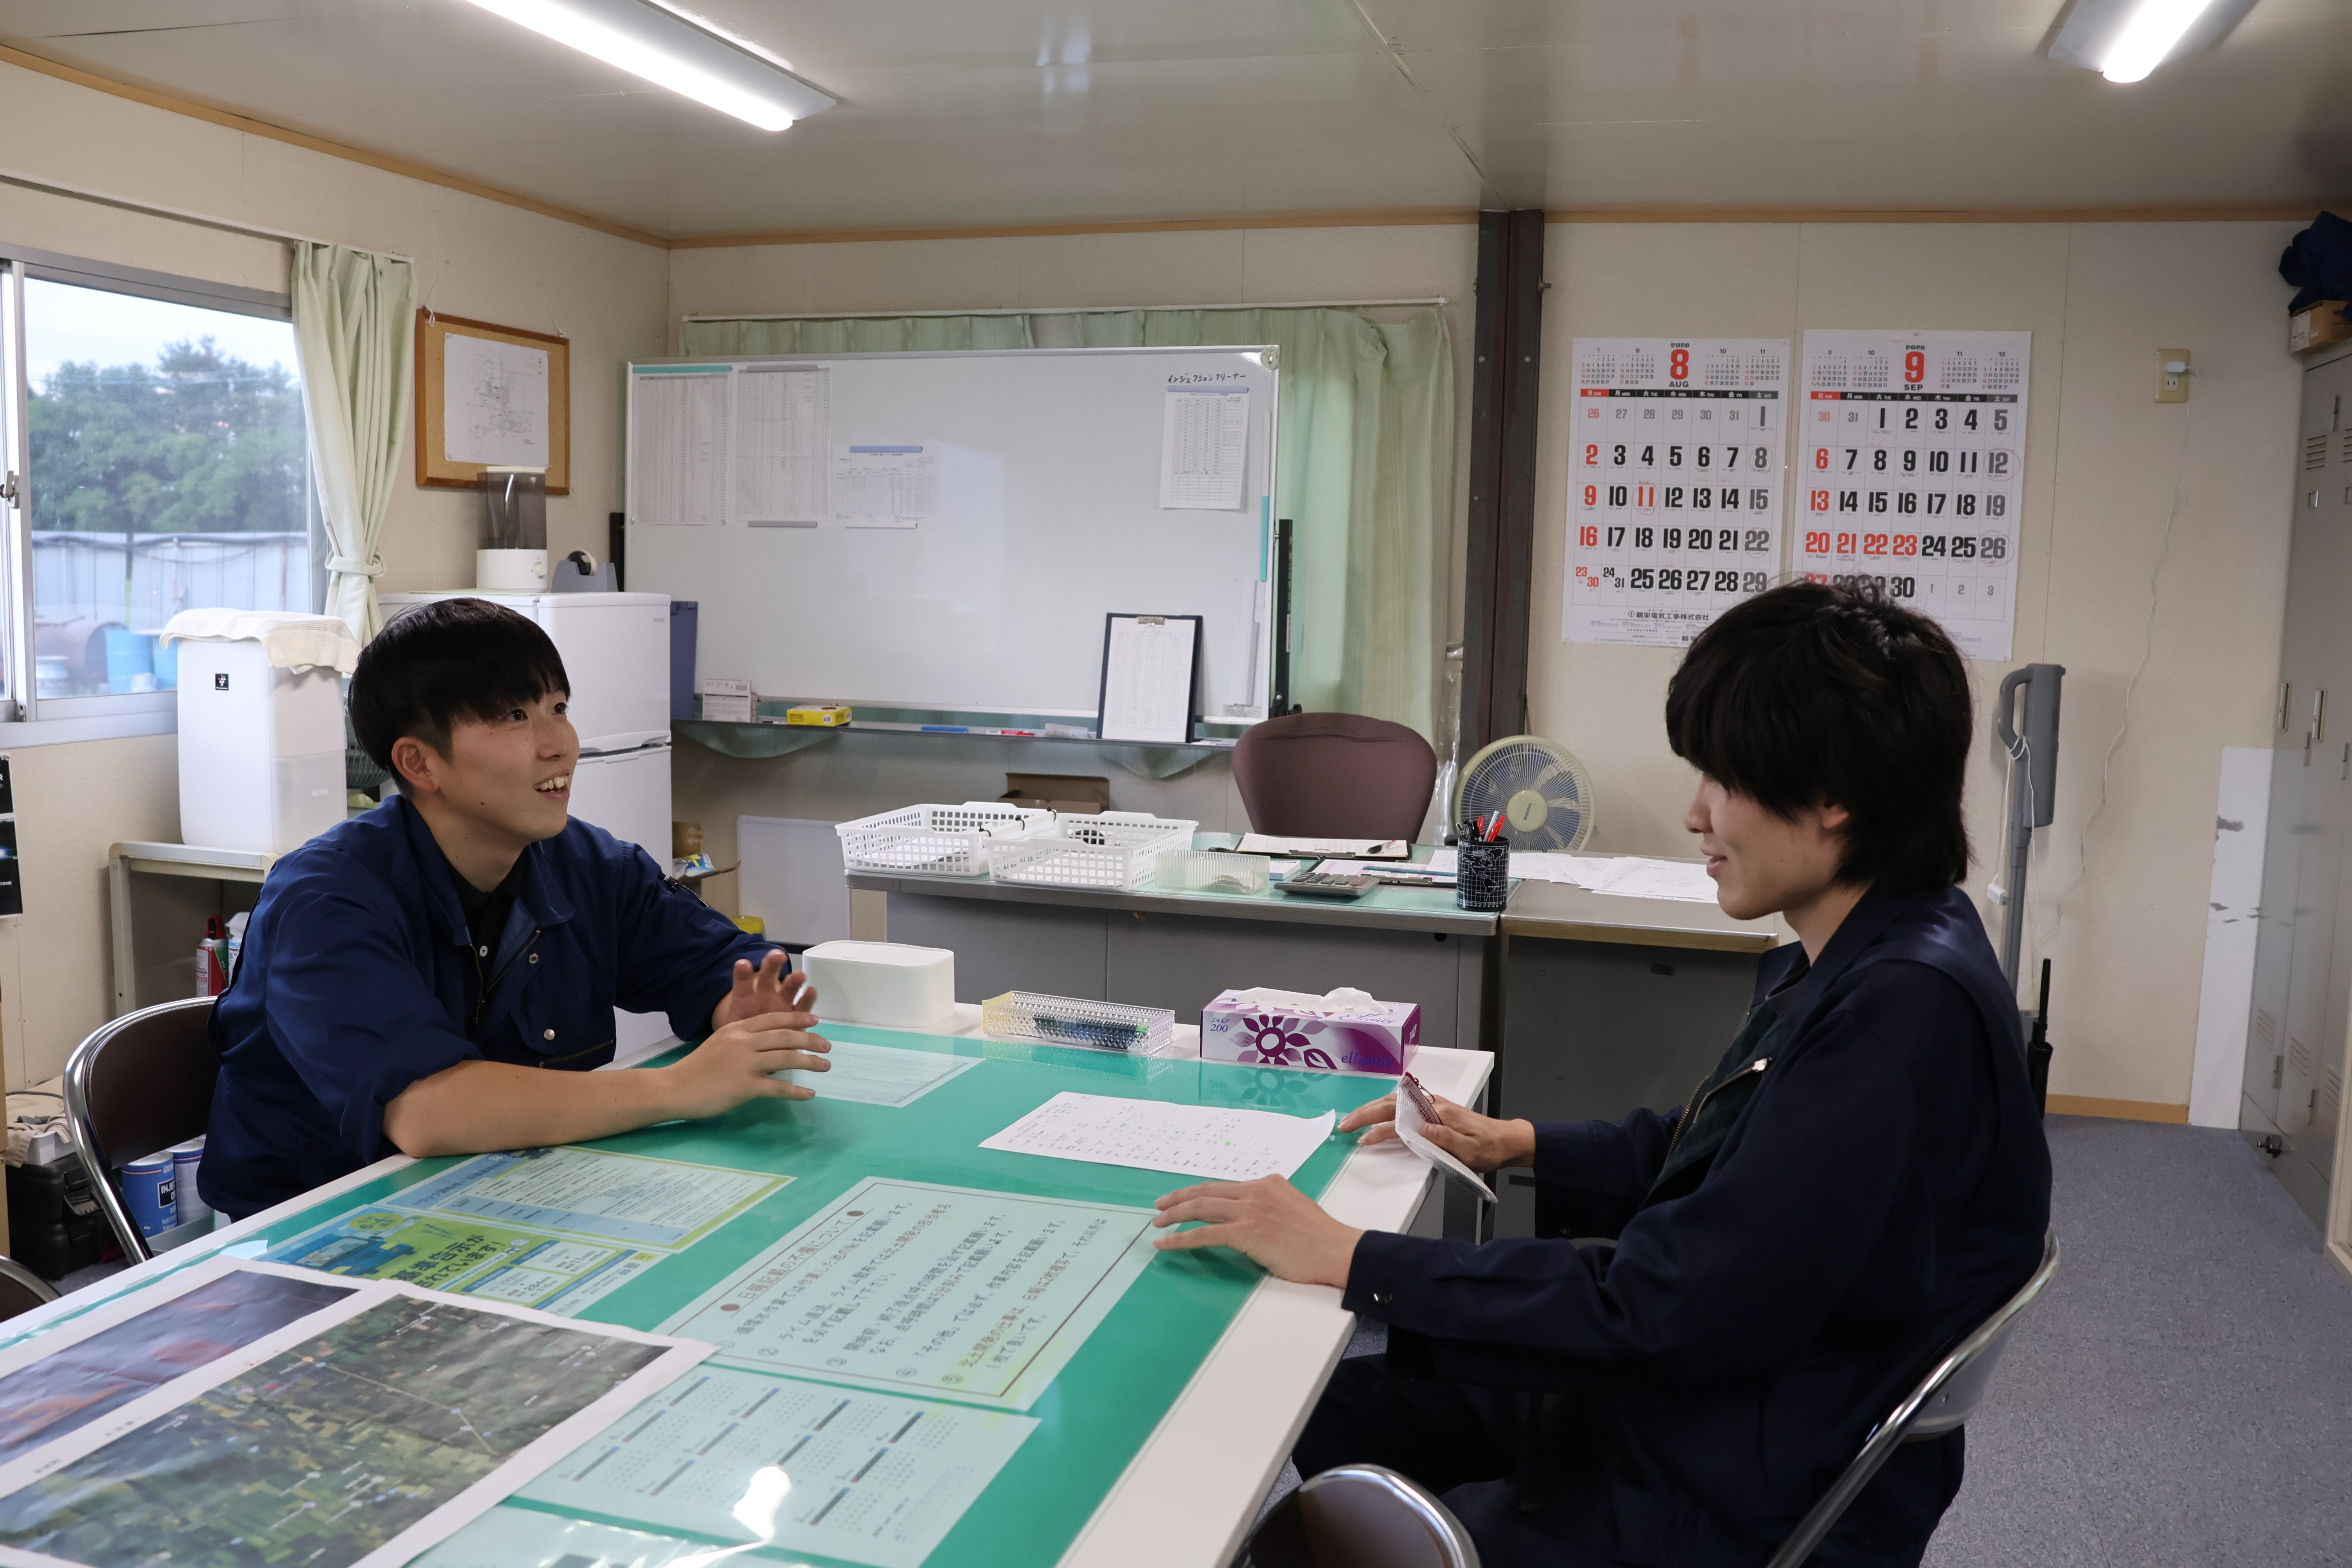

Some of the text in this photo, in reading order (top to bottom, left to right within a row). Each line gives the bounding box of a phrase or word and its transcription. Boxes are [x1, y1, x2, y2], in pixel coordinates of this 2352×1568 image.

[1670, 349, 1689, 380] 8
[1905, 351, 1925, 383] 9
[1588, 408, 1739, 421] 26 27 28 29 30 31
[1760, 406, 1766, 427] 1
[1818, 411, 1858, 423] 30 31
[1880, 408, 2008, 431] 1 2 3 4 5
[1586, 444, 1767, 468] 2 3 4 5 6 7 8
[1816, 448, 2008, 474] 6 7 8 9 10 11 12
[1584, 485, 1769, 510] 9 10 11 12 13 14 15
[1811, 490, 2005, 517] 13 14 15 16 17 18 19
[1580, 526, 1769, 552] 16 17 18 19 20 21 22
[1805, 532, 2006, 559] 20 21 22 23 24 25 26
[1575, 566, 1767, 593] 23 24 25 26 27 28 29
[1587, 576, 1624, 588] 30 31
[1890, 576, 1915, 598] 30
[1930, 583, 1994, 596] 1 2 3
[1210, 1024, 1228, 1032] 200
[1341, 1052, 1392, 1067] ellemoi
[734, 1219, 855, 1300] 日報記載の不備について
